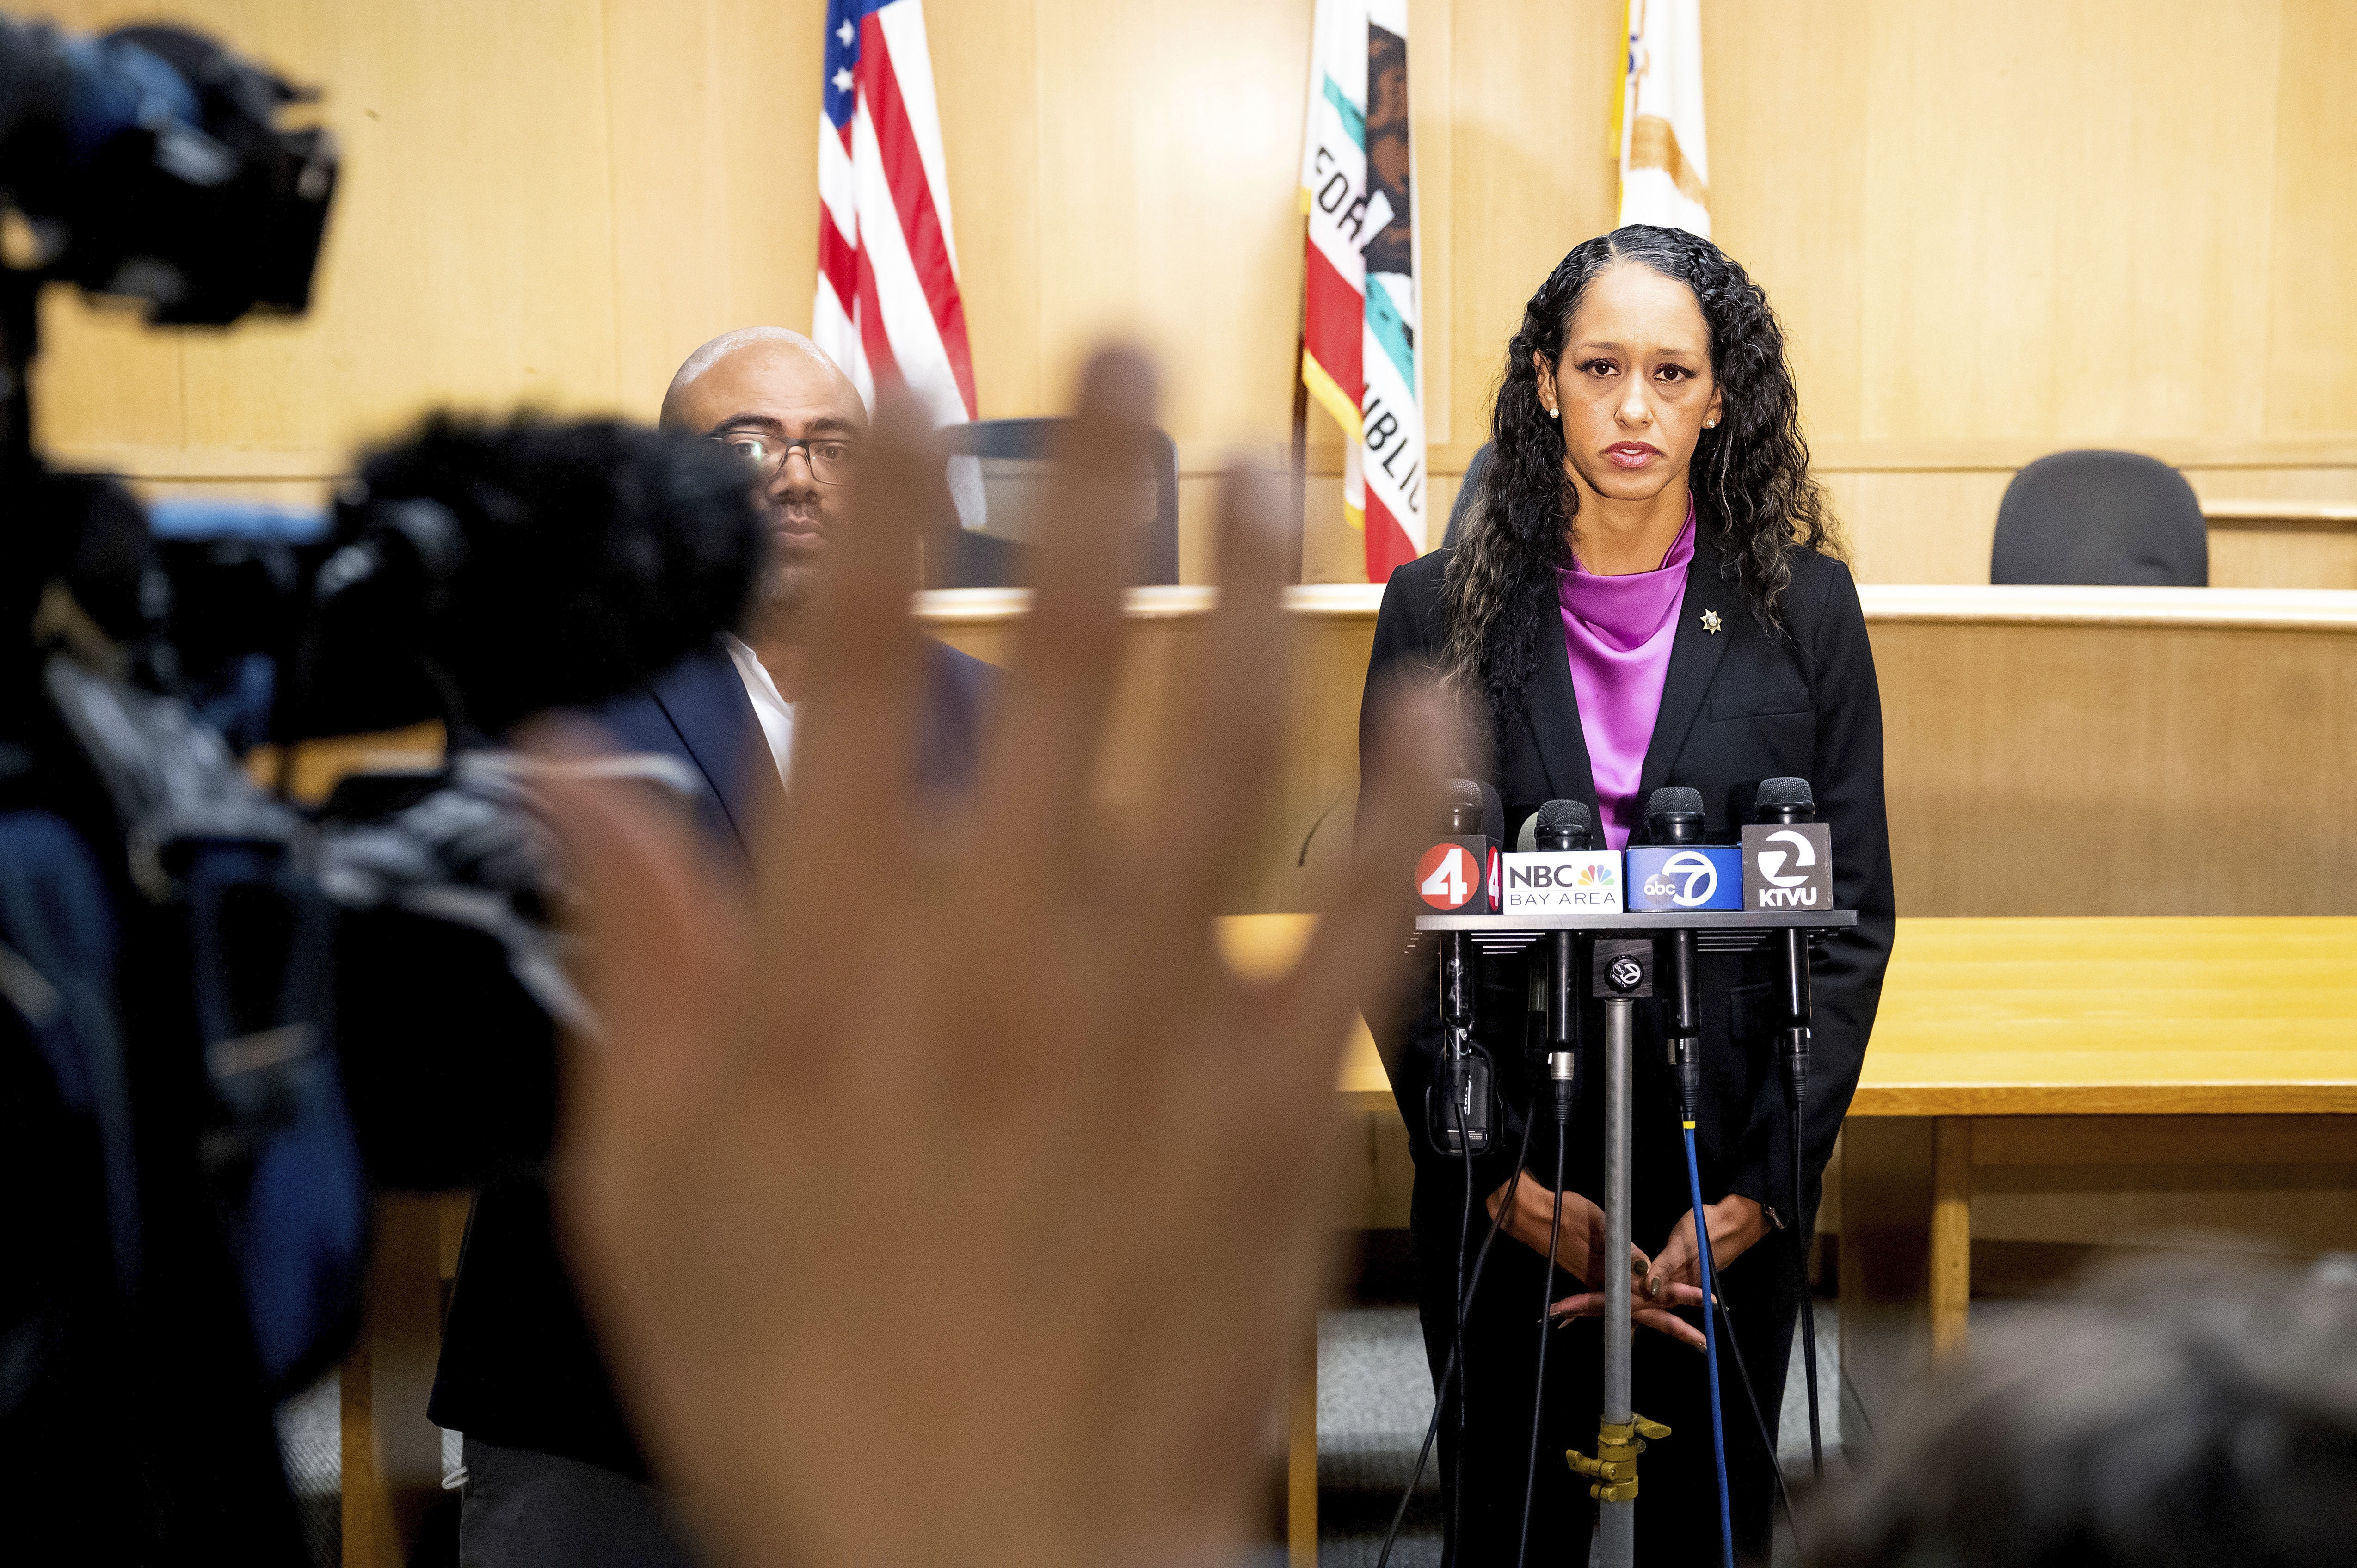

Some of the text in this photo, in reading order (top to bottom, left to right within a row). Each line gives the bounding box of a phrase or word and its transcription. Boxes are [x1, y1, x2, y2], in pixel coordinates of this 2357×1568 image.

[1422, 848, 1467, 904] 4
[1510, 865, 1572, 888] NBC
[1758, 831, 1815, 887] 2
[1488, 851, 1499, 907] 4
[1644, 852, 1717, 906] abc 7
[1759, 887, 1817, 907] KTVU
[1510, 892, 1616, 905] BAY AREA
[1614, 963, 1640, 984] abc 7
